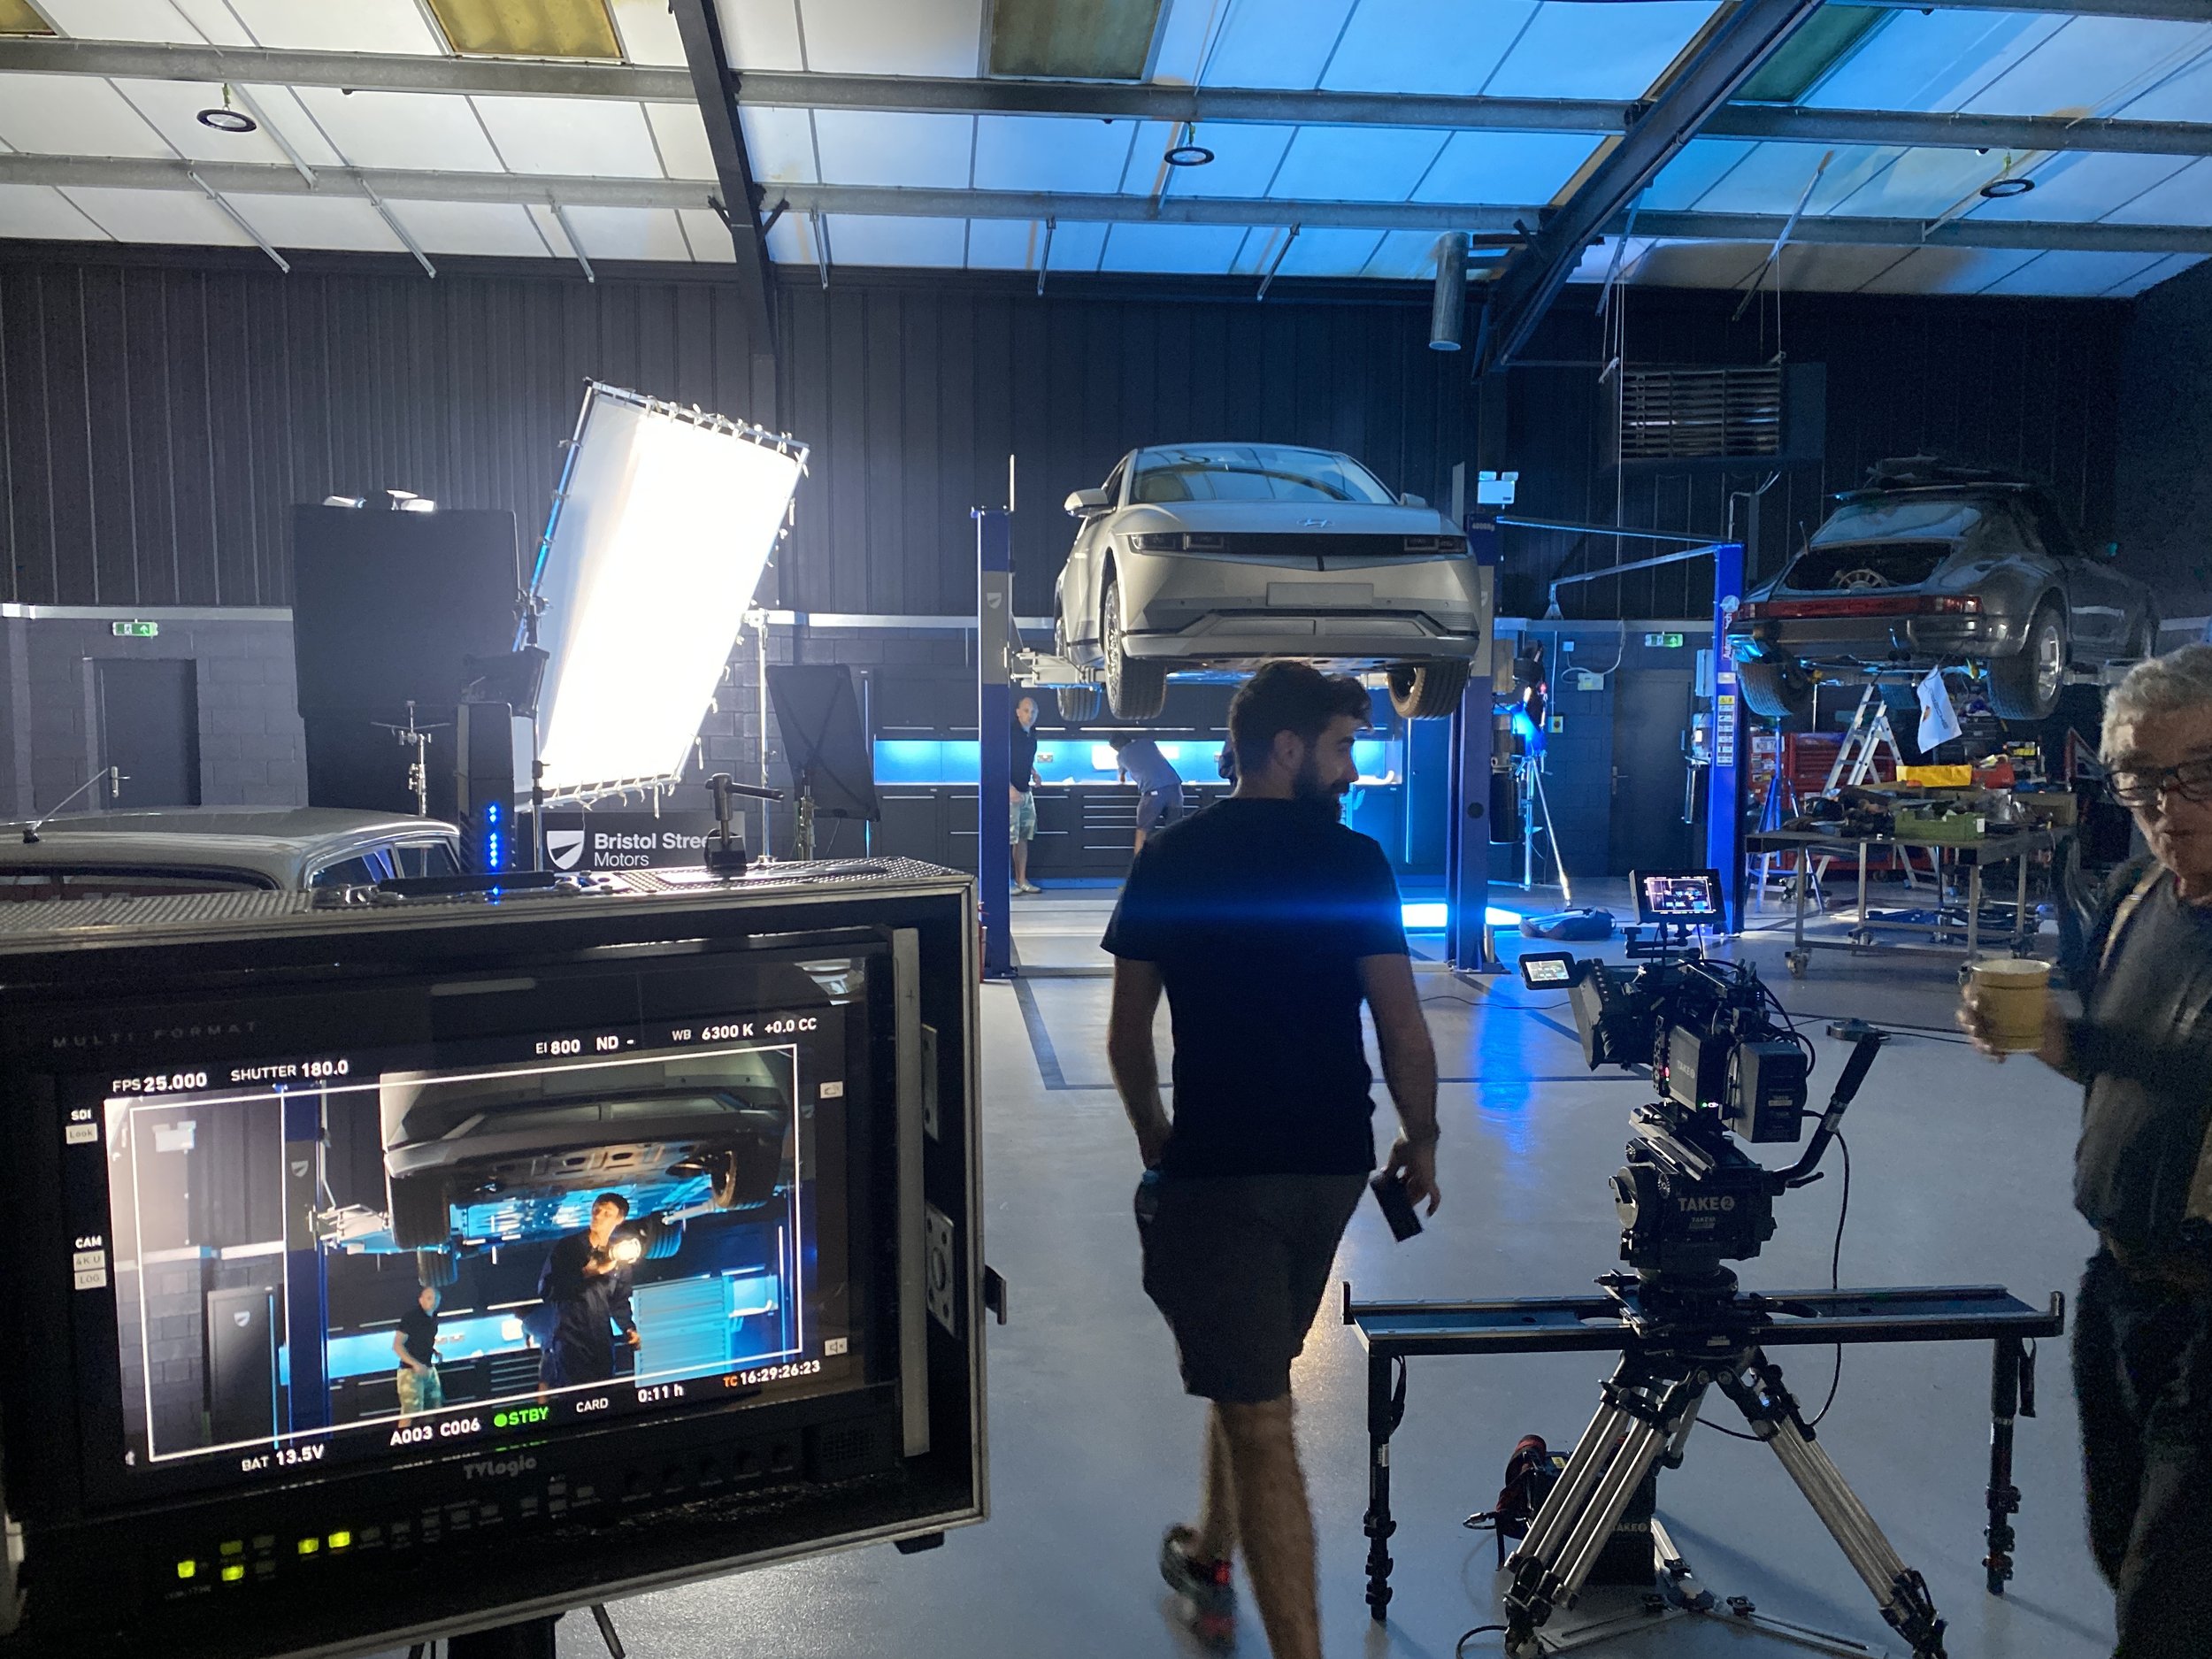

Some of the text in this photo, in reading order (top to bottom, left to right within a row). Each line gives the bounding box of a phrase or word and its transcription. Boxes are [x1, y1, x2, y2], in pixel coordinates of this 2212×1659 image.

[594, 832, 709, 850] Bristol Stre
[594, 852, 649, 868] Motors
[52, 1020, 257, 1049] MULTI FORMAT
[672, 1022, 754, 1041] WB 6300 K
[764, 1017, 817, 1034] +0.0 CC
[550, 1039, 580, 1056] 800
[596, 1035, 619, 1050] ND
[230, 1059, 349, 1082] SHUTTER 180.0
[112, 1071, 208, 1094] FPS 25.000
[71, 1109, 92, 1121] SDI
[75, 1235, 103, 1248] CAM
[723, 1360, 820, 1387] TC 16:29:26:23
[637, 1384, 684, 1402] 0:11 h
[576, 1397, 609, 1414] CARD
[509, 1407, 549, 1425] STBY
[390, 1418, 481, 1446] A003 C006
[242, 1445, 325, 1472] BAT 13.5V
